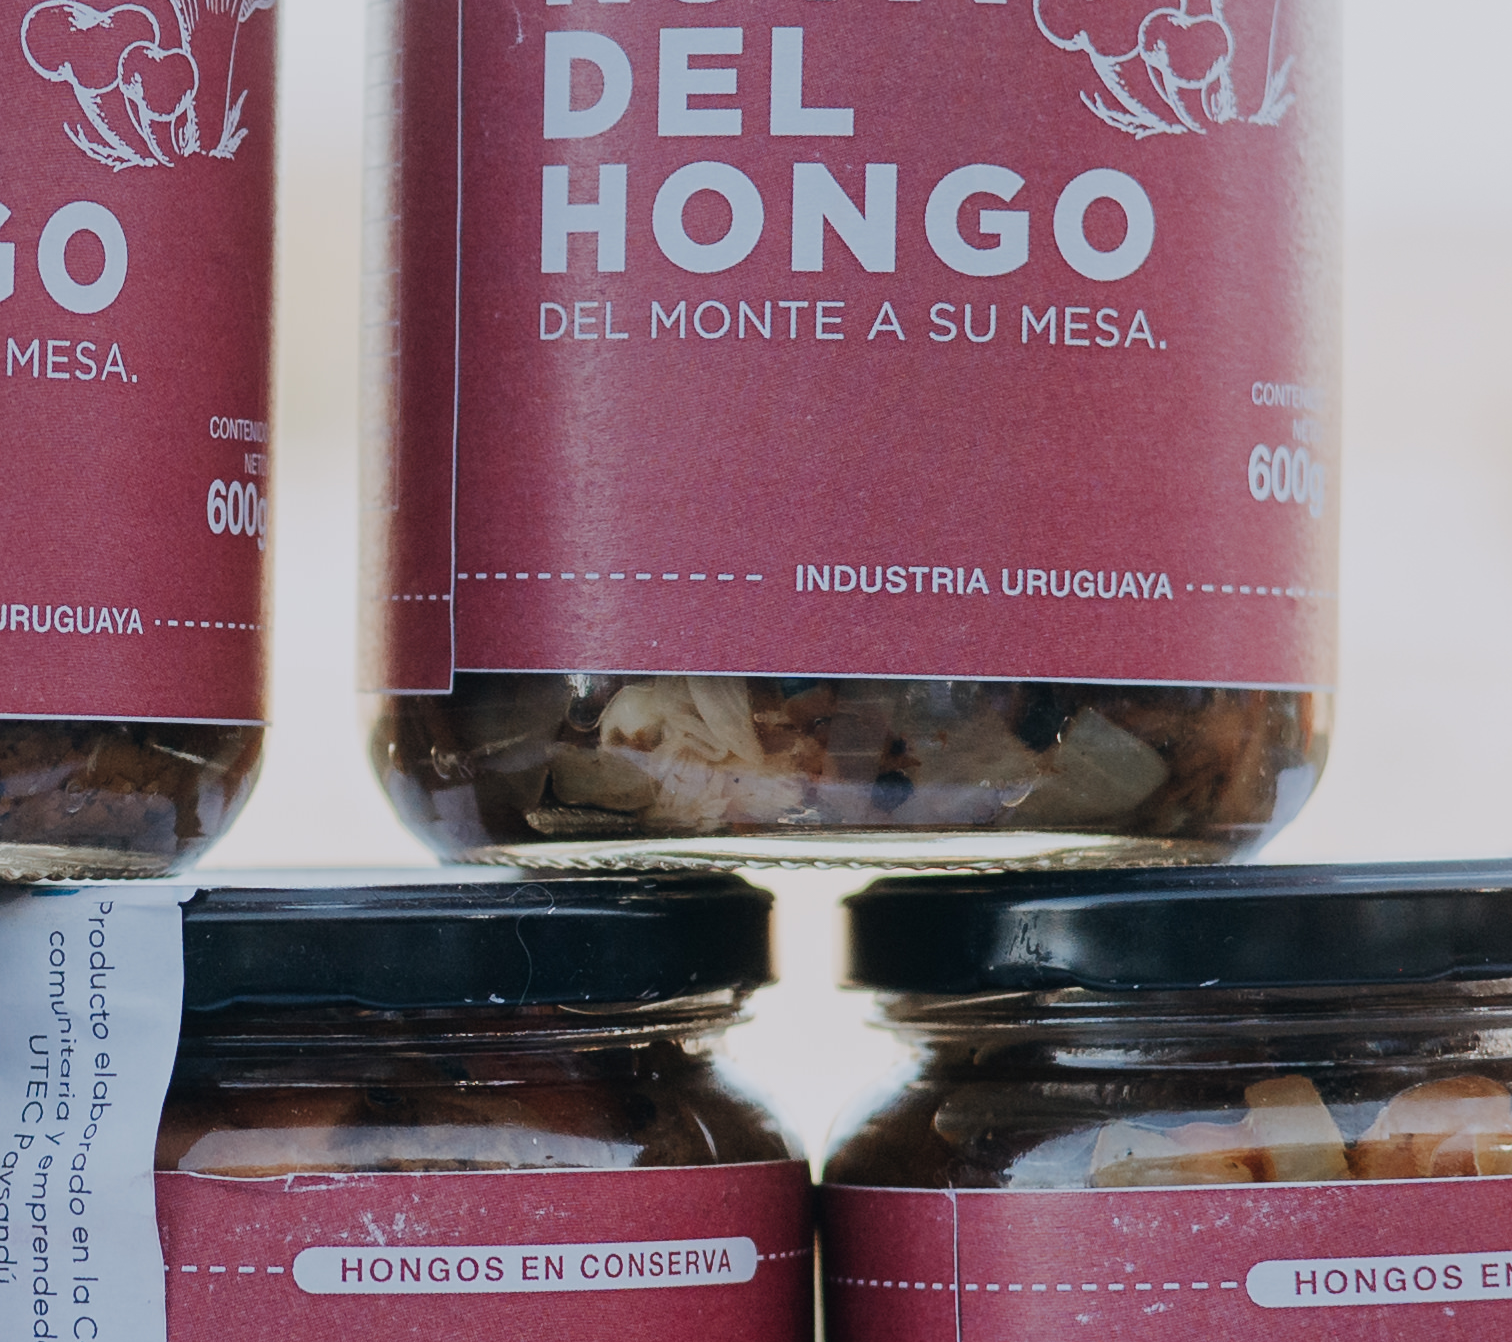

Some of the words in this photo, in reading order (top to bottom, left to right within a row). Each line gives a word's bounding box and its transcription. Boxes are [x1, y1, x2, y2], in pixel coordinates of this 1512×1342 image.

[544, 27, 854, 140] DEL
[541, 161, 1155, 281] HONGO
[541, 302, 629, 340] DEL
[651, 301, 844, 339] MONTE
[868, 302, 905, 340] A
[929, 303, 996, 342] SU
[1022, 306, 1166, 349] MESA.
[7, 338, 137, 382] MESA.
[1248, 443, 1324, 518] 600g
[207, 479, 267, 551] 600g
[796, 565, 989, 594] INDUSTRIA
[1002, 569, 1173, 599] URUGUAYA
[87, 899, 114, 1040] Producto
[48, 930, 73, 1121] comunitaria
[21, 1034, 50, 1124] UTEC
[43, 1131, 66, 1147] y
[67, 1053, 113, 1218] elaborado
[71, 1226, 89, 1264] en
[342, 1257, 503, 1282] HONGOS
[522, 1256, 563, 1280] EN
[581, 1249, 731, 1279] CONSERVA
[72, 1275, 99, 1305] la
[1295, 1265, 1462, 1295] HONGOS
